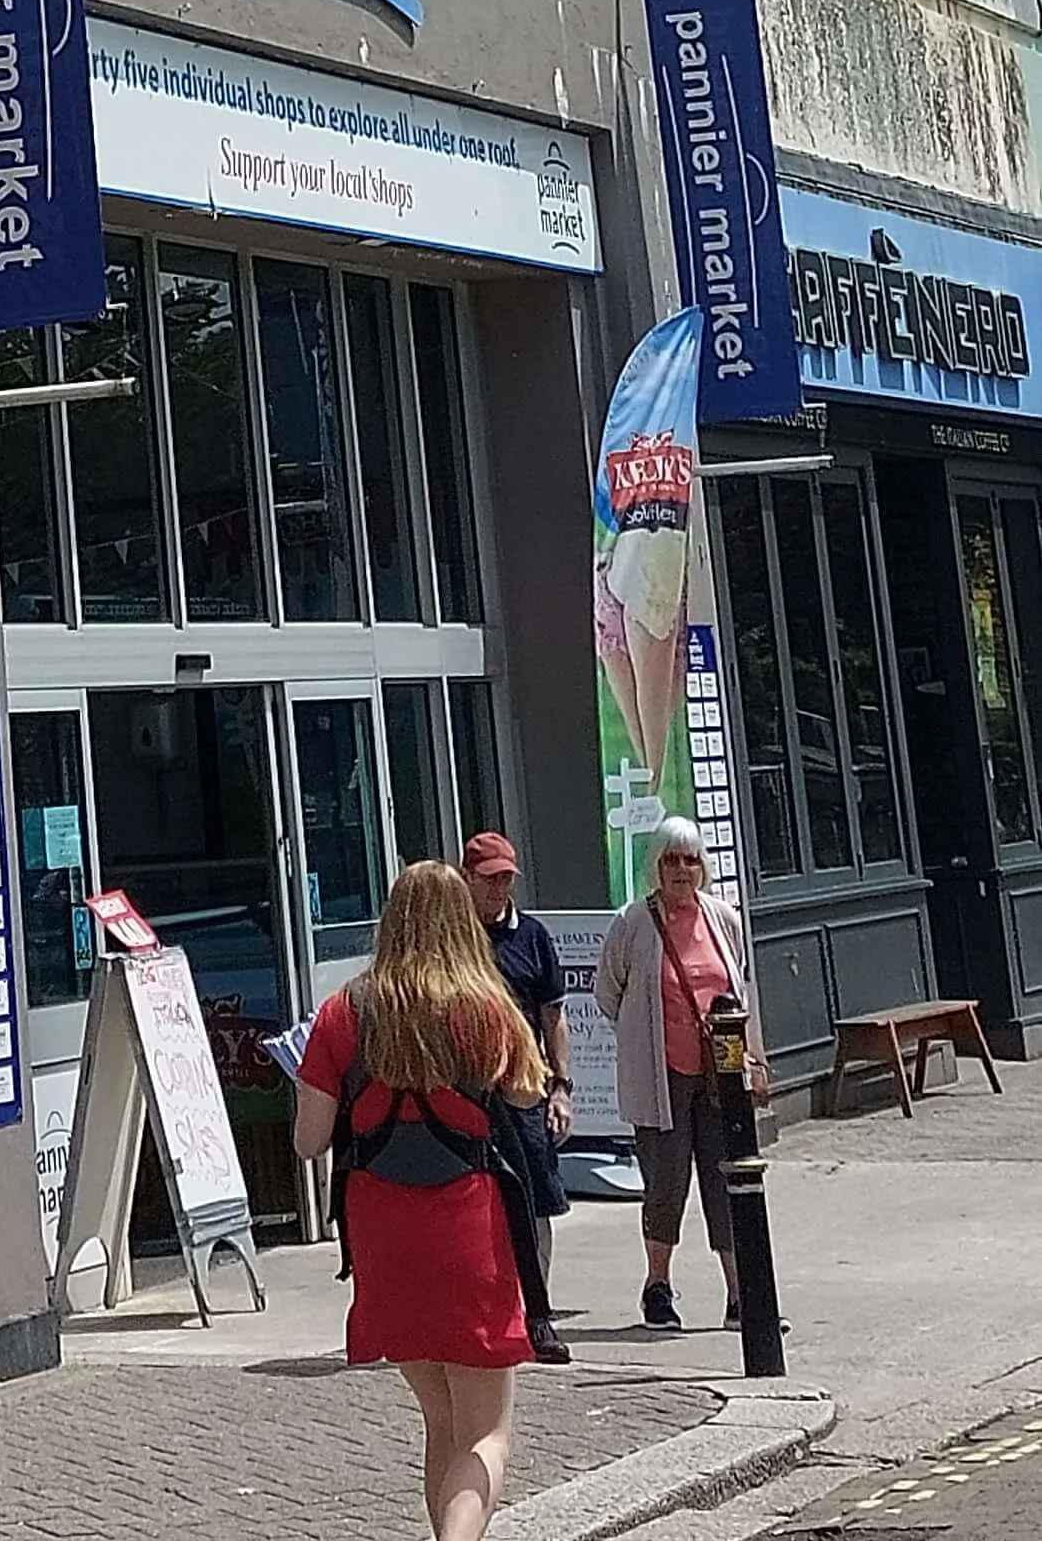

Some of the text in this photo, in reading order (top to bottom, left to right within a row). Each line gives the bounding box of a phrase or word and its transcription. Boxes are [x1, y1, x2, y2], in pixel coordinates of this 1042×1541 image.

[92, 51, 119, 94] rty
[124, 49, 159, 92] five
[163, 57, 253, 113] individual
[257, 80, 306, 131] shops
[309, 97, 326, 127] to
[329, 103, 387, 144] explore
[392, 112, 408, 146] all
[412, 119, 456, 156] under
[459, 136, 485, 160] one
[221, 137, 414, 217] Support your local shops
[537, 172, 580, 205] pannier
[666, 10, 754, 380] pannier market
[540, 207, 586, 242] market
